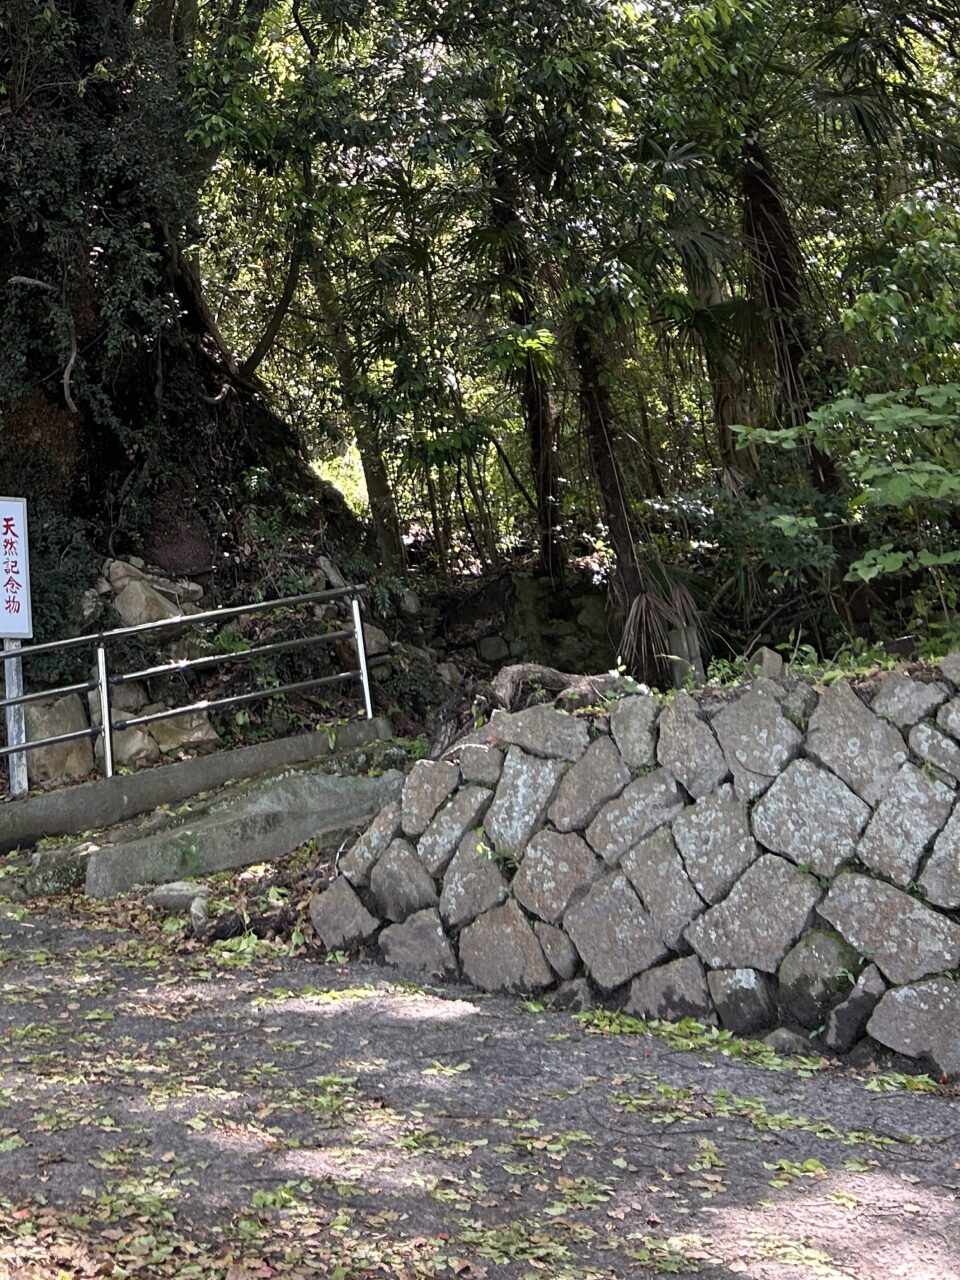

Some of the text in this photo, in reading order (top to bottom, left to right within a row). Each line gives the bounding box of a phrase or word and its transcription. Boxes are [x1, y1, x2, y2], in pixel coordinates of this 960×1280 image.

[3, 516, 22, 614] 天然記念物
